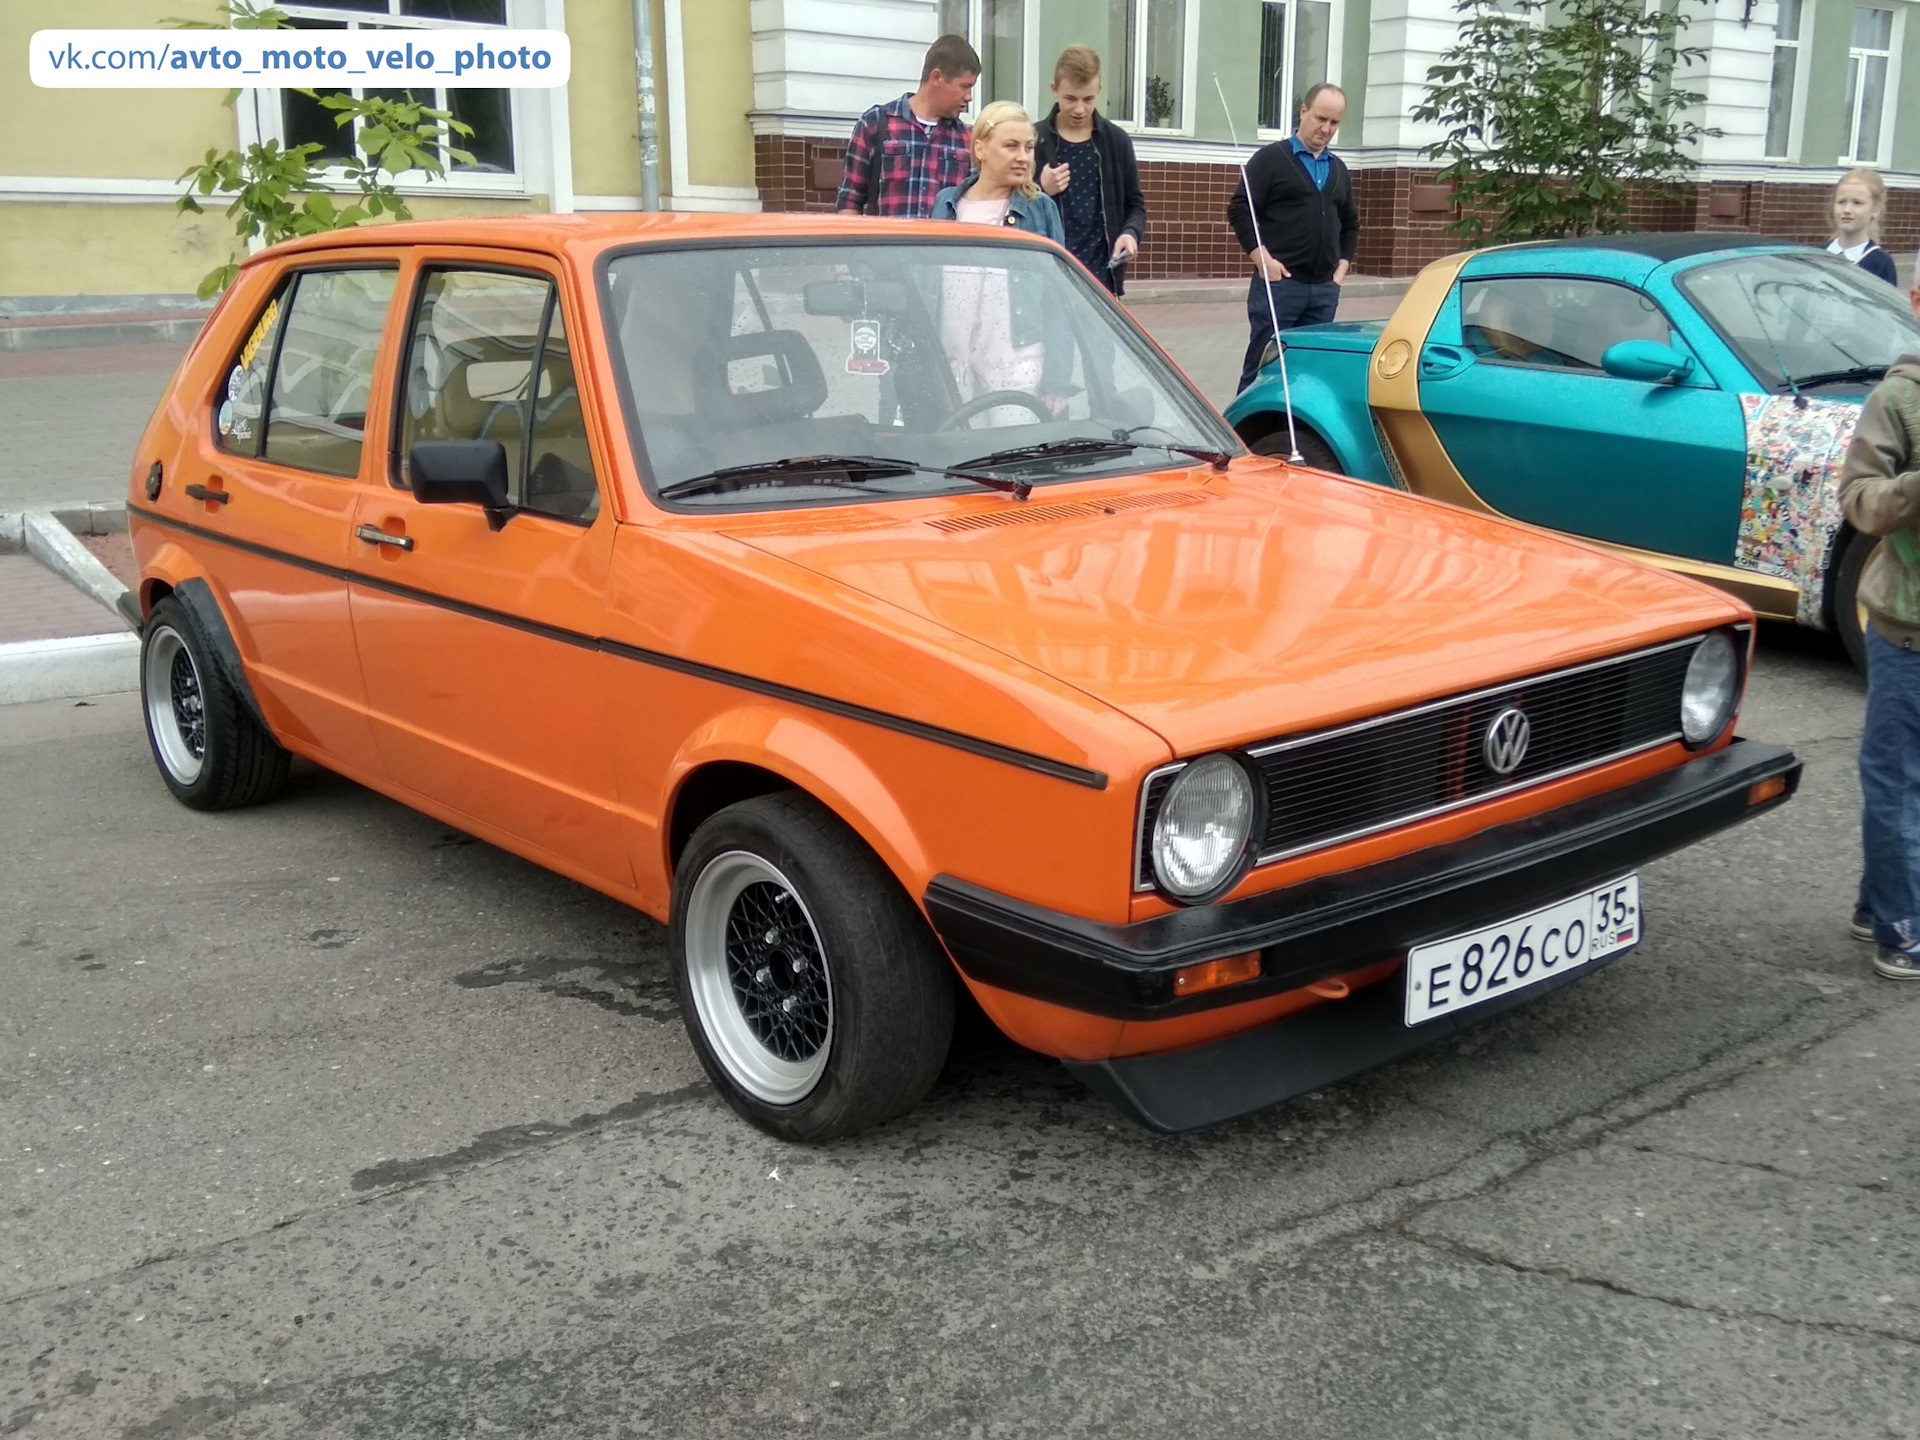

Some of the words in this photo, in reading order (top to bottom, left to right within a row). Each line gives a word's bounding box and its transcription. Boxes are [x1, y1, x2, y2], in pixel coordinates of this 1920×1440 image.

[1488, 709, 1530, 774] VW
[1428, 919, 1586, 1009] E826CO
[1597, 886, 1628, 933] 35
[1592, 930, 1616, 952] RUS
